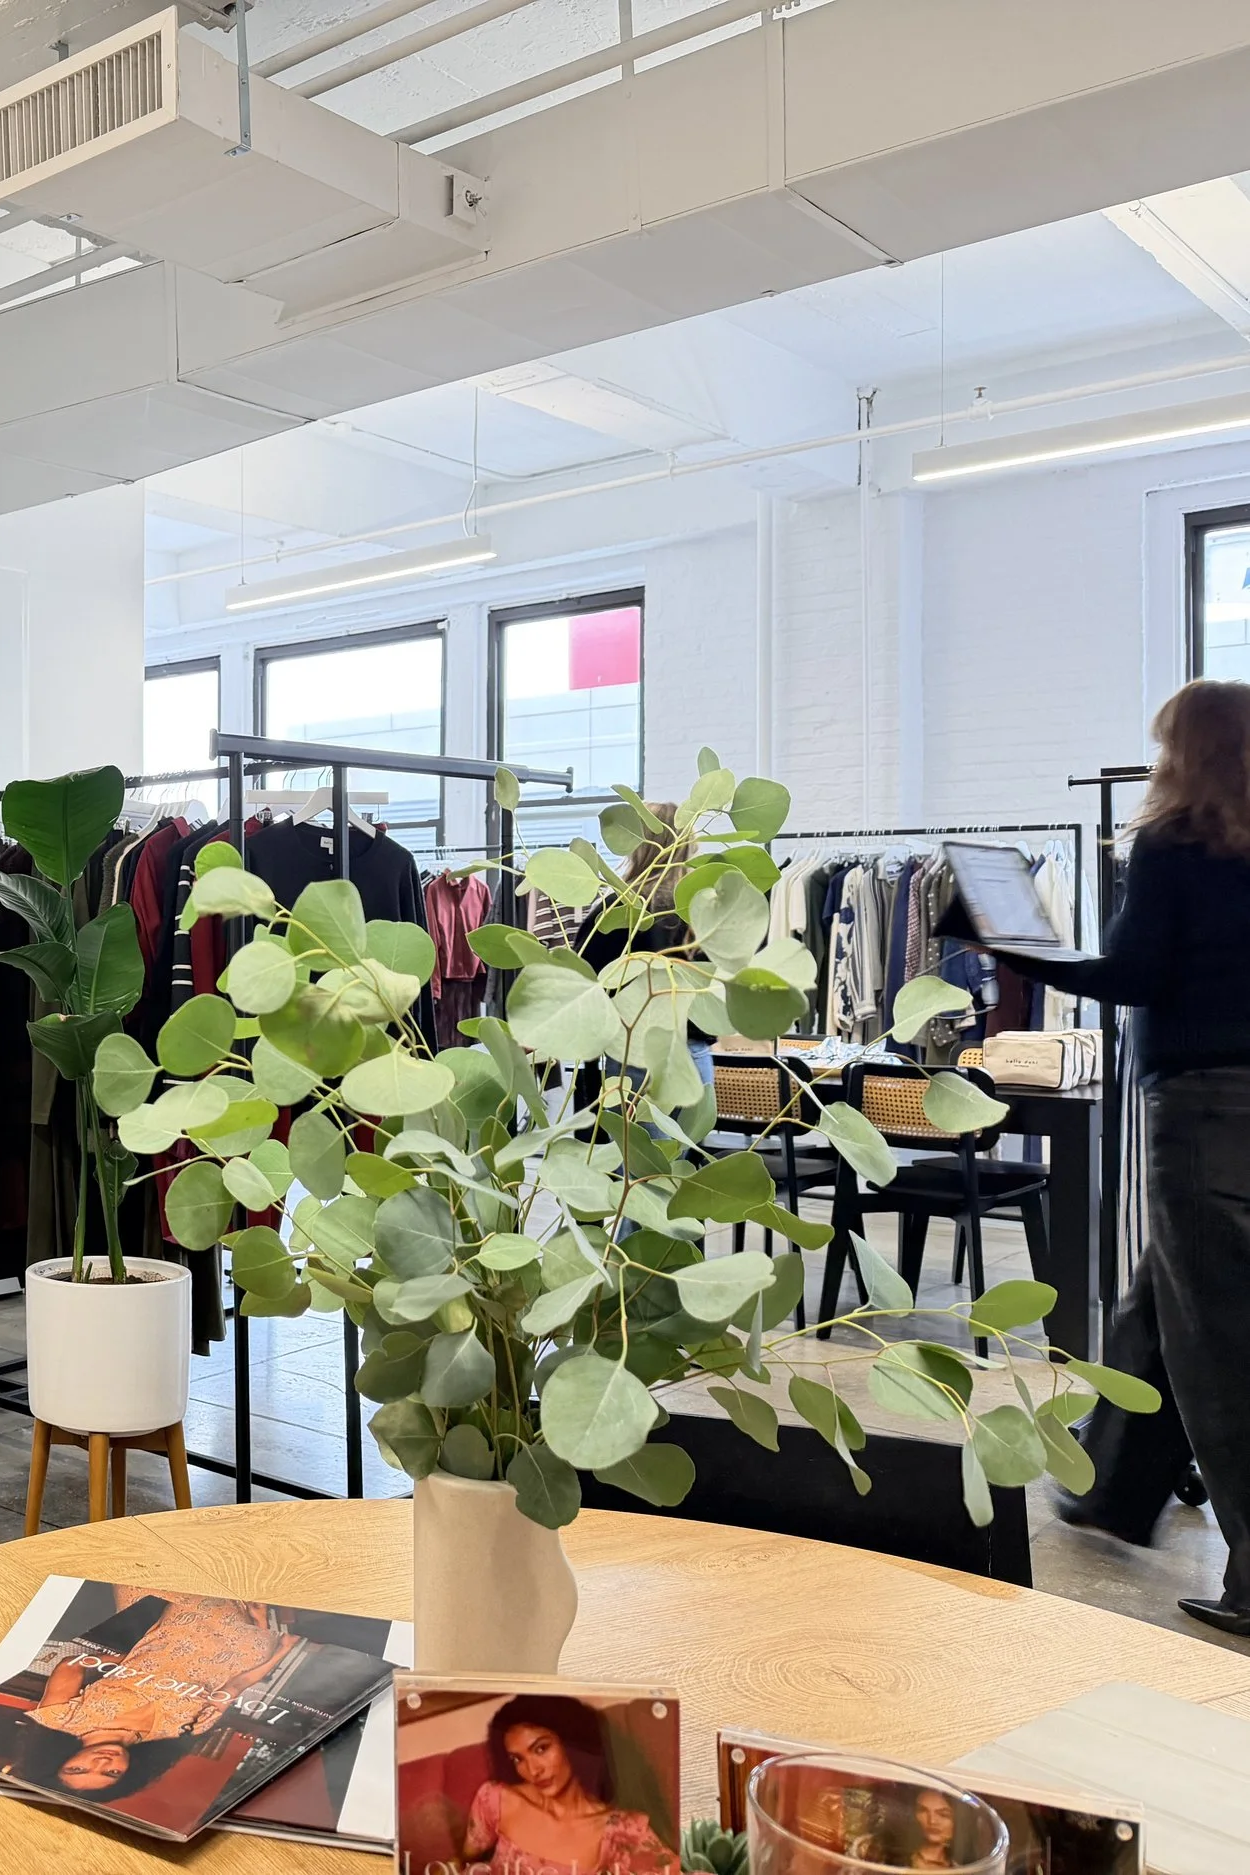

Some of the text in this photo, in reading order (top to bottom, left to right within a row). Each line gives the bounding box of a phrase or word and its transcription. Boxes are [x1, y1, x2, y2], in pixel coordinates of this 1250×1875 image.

[66, 1652, 290, 1725] Love the Label
[303, 1705, 335, 1720] AUTUMN
